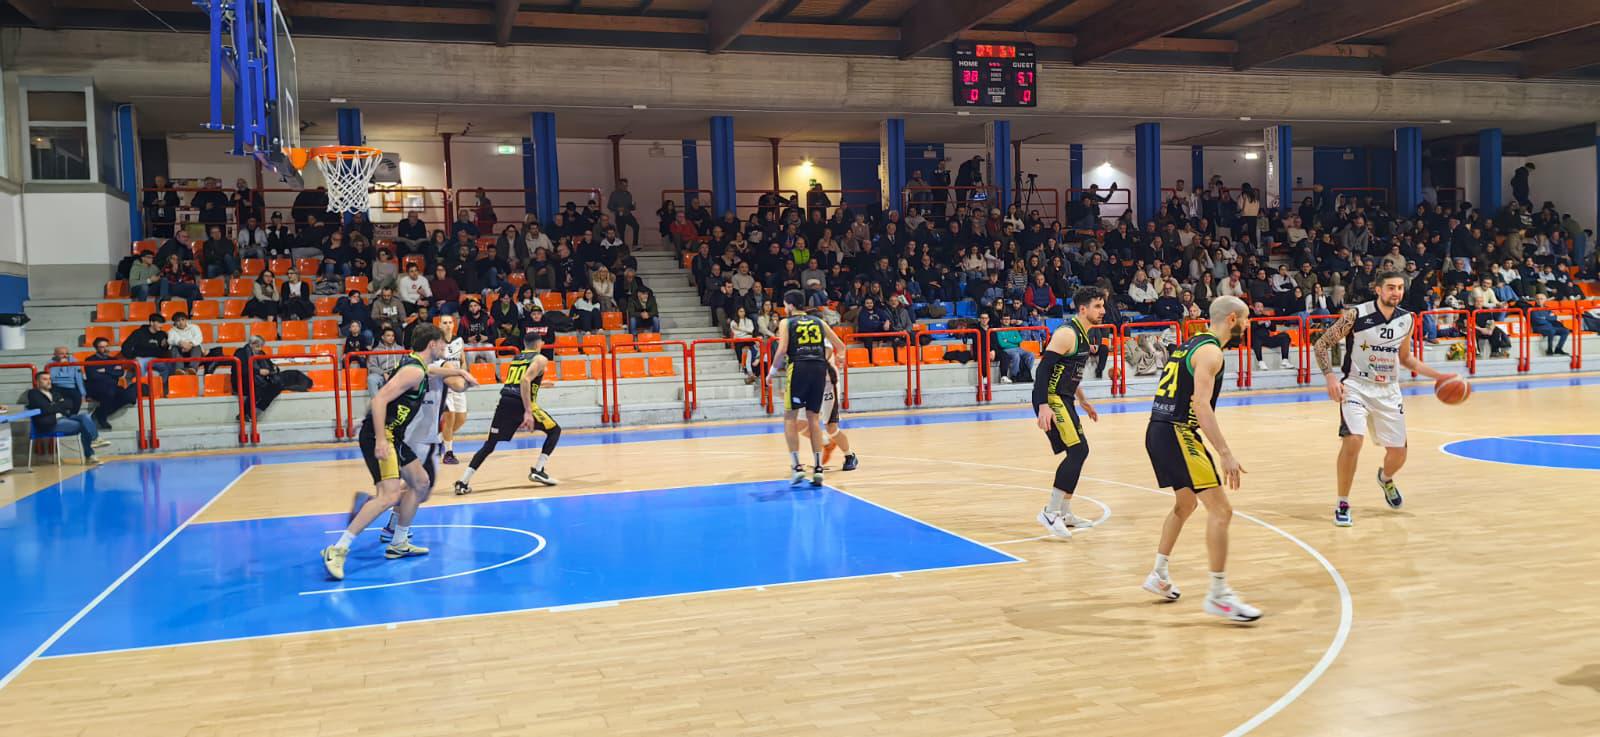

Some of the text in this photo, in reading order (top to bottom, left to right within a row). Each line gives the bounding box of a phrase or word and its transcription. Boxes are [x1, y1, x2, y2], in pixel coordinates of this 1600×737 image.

[971, 89, 979, 101] 0
[1023, 90, 1031, 102] 0
[796, 325, 822, 344] 33
[1380, 328, 1394, 339] 20
[505, 366, 528, 385] 00
[824, 392, 833, 401] 23
